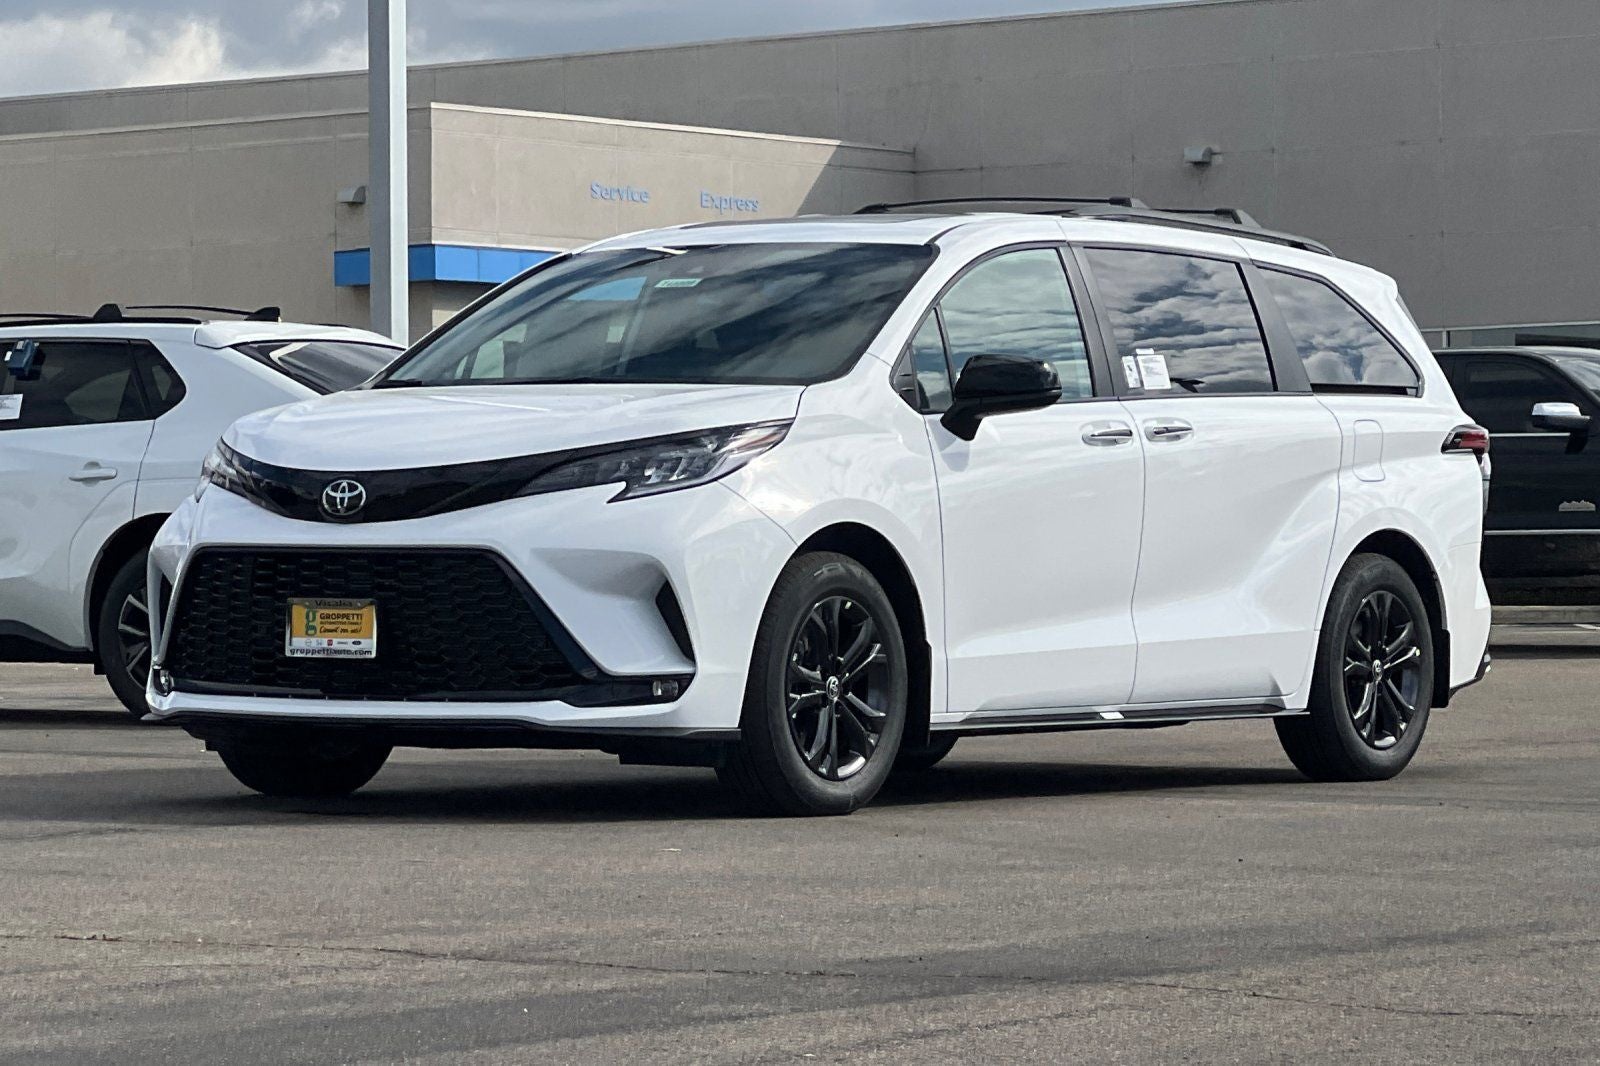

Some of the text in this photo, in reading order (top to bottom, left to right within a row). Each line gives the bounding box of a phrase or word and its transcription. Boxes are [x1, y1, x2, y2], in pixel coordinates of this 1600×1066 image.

[590, 180, 759, 215] Service Express
[319, 612, 363, 621] GROPPETTI
[289, 646, 373, 656] groppettiauto.com
